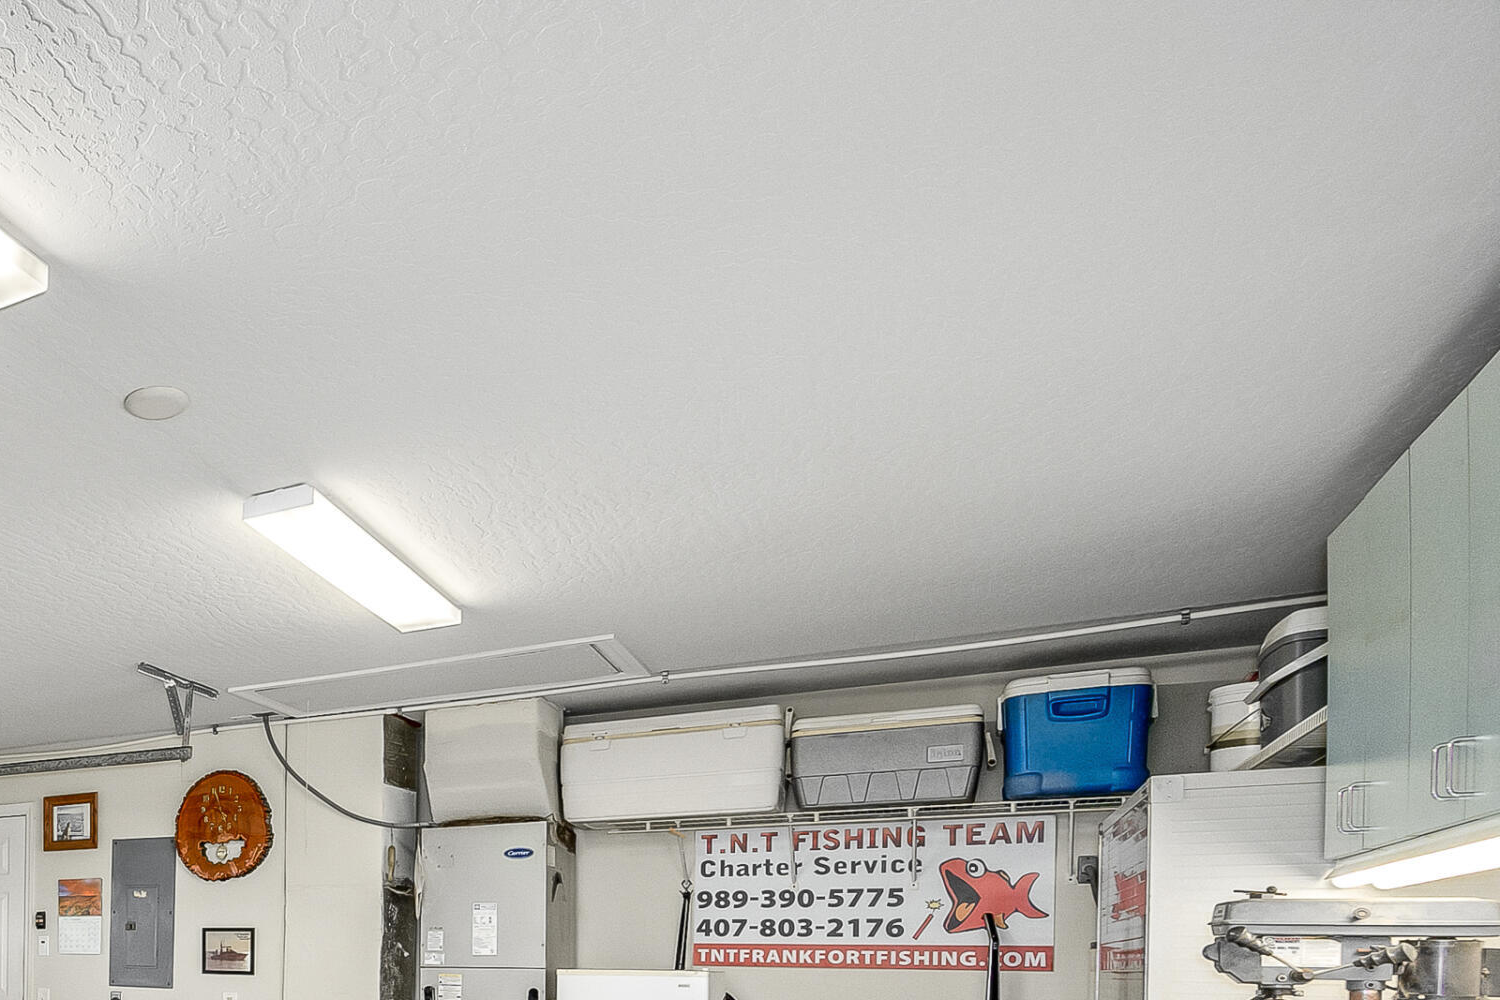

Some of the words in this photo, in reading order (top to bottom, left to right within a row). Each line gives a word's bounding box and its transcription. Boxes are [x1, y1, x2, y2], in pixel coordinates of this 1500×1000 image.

[701, 832, 779, 854] T.N.T
[792, 826, 926, 851] FISHING
[943, 820, 1045, 846] TEAM
[700, 859, 803, 877] Charter
[813, 855, 922, 875] Service
[696, 888, 904, 909] 989-390-5775
[696, 918, 904, 938] 407-803-2176
[697, 949, 1047, 967] TNTFRANKFORTFISHING.OM
